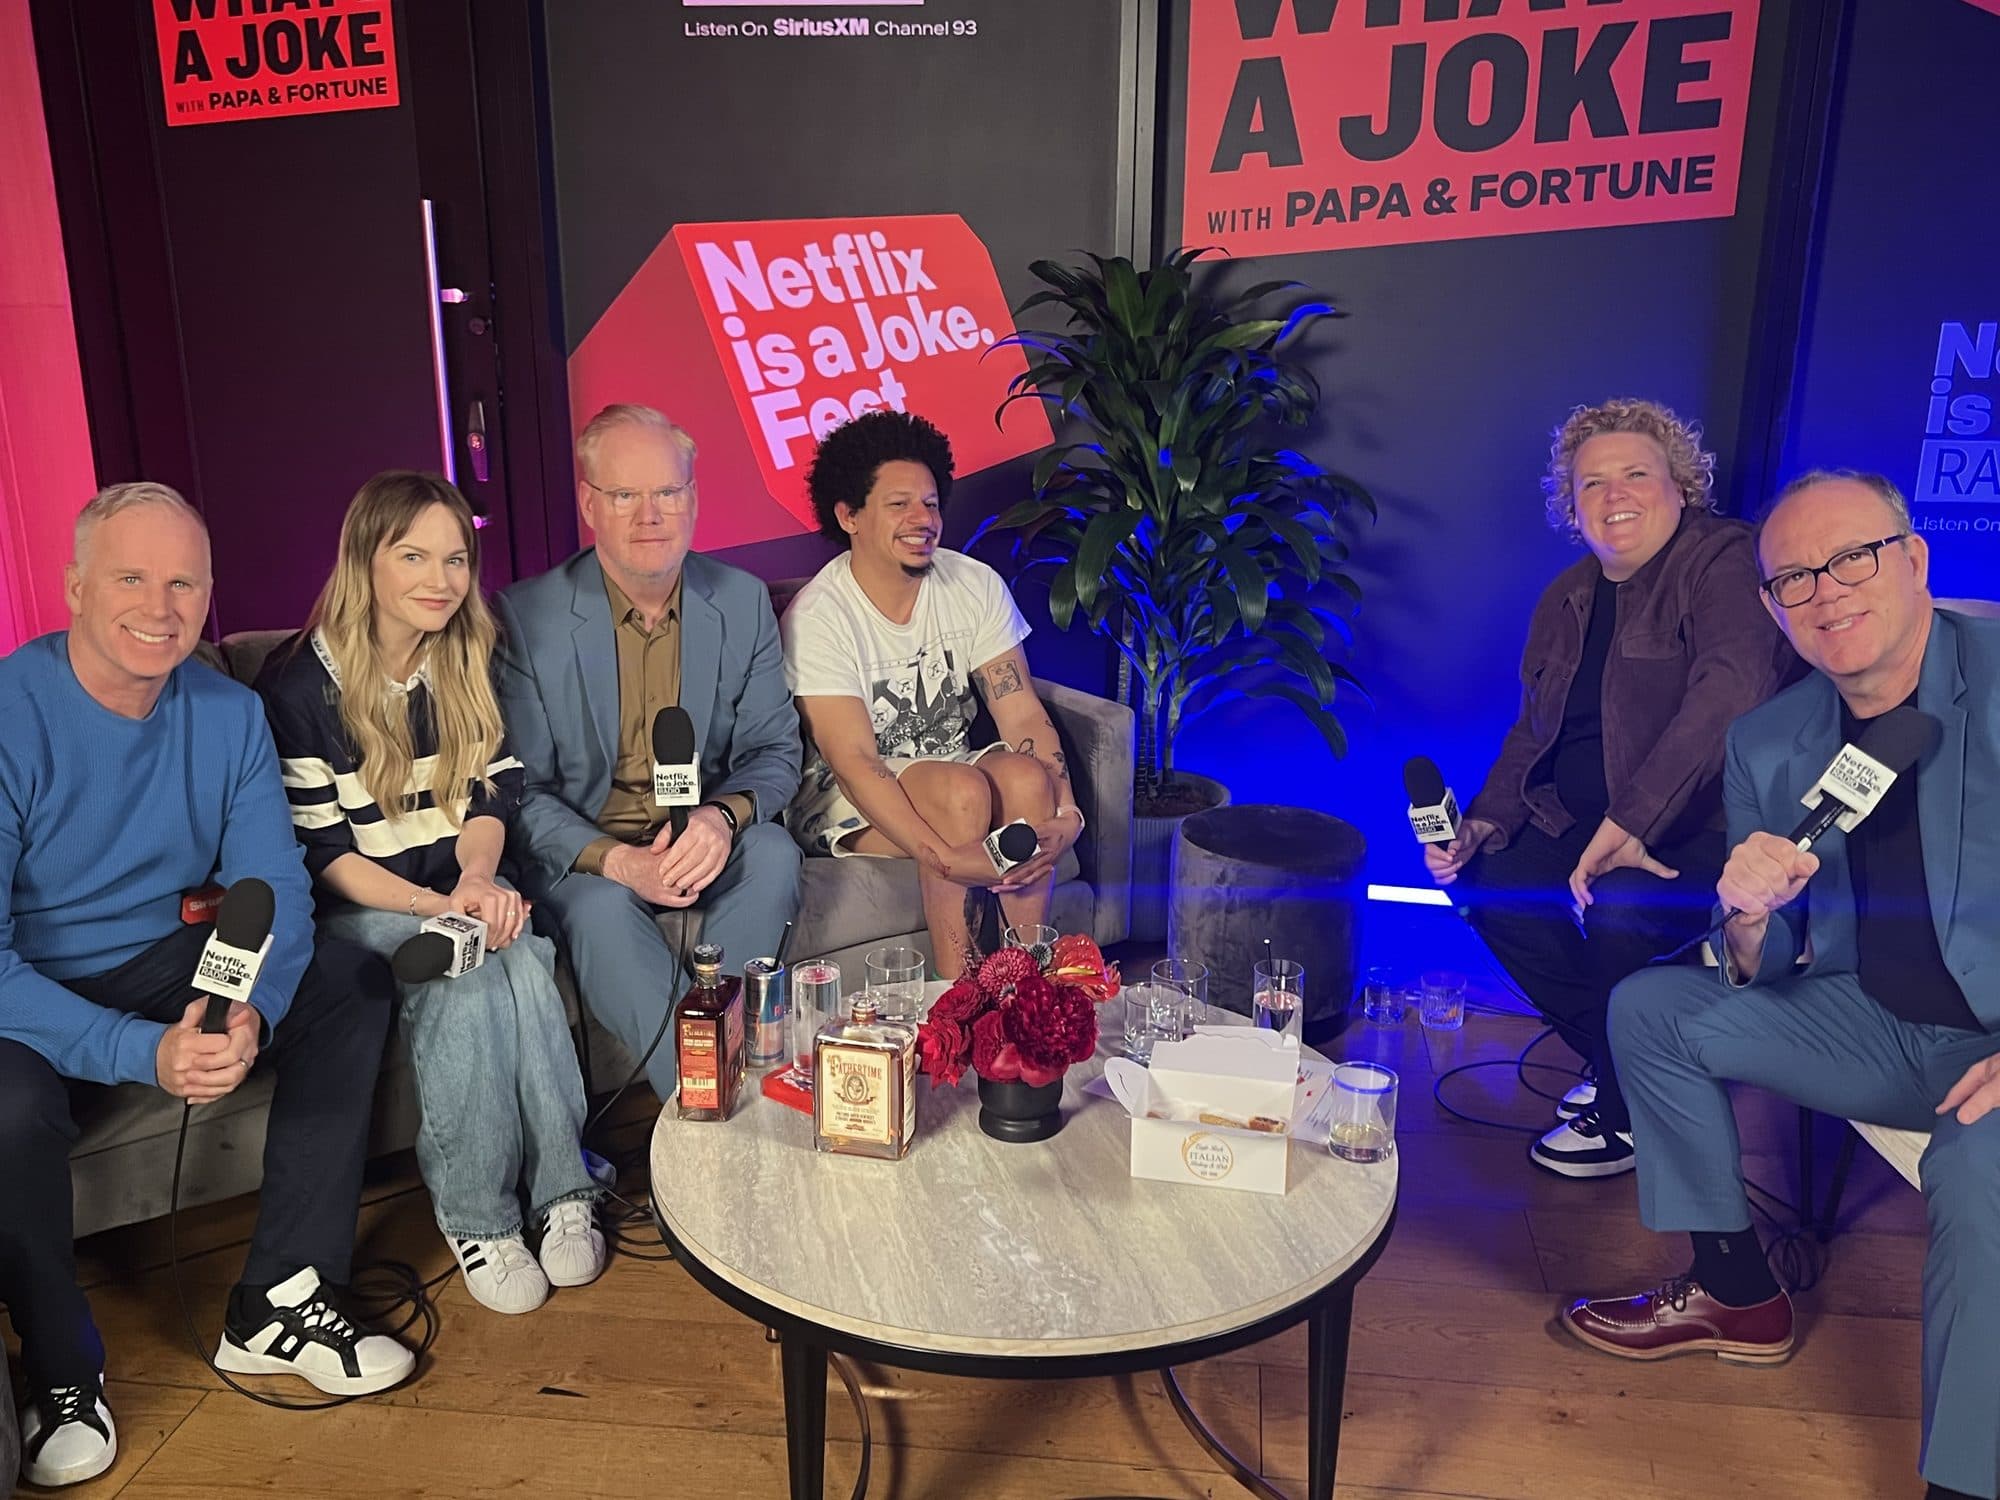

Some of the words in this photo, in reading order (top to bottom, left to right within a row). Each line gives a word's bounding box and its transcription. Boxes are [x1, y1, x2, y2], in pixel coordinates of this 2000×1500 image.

[174, 29, 213, 84] A
[225, 11, 385, 80] JOKE
[684, 22, 738, 36] Listen
[741, 21, 768, 36] On
[773, 18, 869, 36] SiriusXM
[874, 20, 949, 36] Channel
[952, 20, 977, 35] 93
[176, 101, 205, 113] WITH
[208, 88, 263, 110] PAPA
[268, 87, 281, 105] &
[287, 77, 387, 104] FORTUNE
[1209, 56, 1304, 174] A
[1339, 11, 1733, 162] JOKE
[1207, 206, 1271, 235] WITH
[1286, 182, 1410, 228] PAPA
[1422, 178, 1457, 216] &
[1470, 155, 1715, 212] FORTUNE
[695, 231, 938, 314] Netflix
[723, 316, 806, 392] is
[808, 325, 857, 378] a
[853, 295, 995, 370] Joke.
[1925, 377, 1991, 435] is
[1841, 752, 1880, 782] Netflix
[204, 949, 247, 969] Netflix
[1190, 1151, 1229, 1163] ITALIAN
